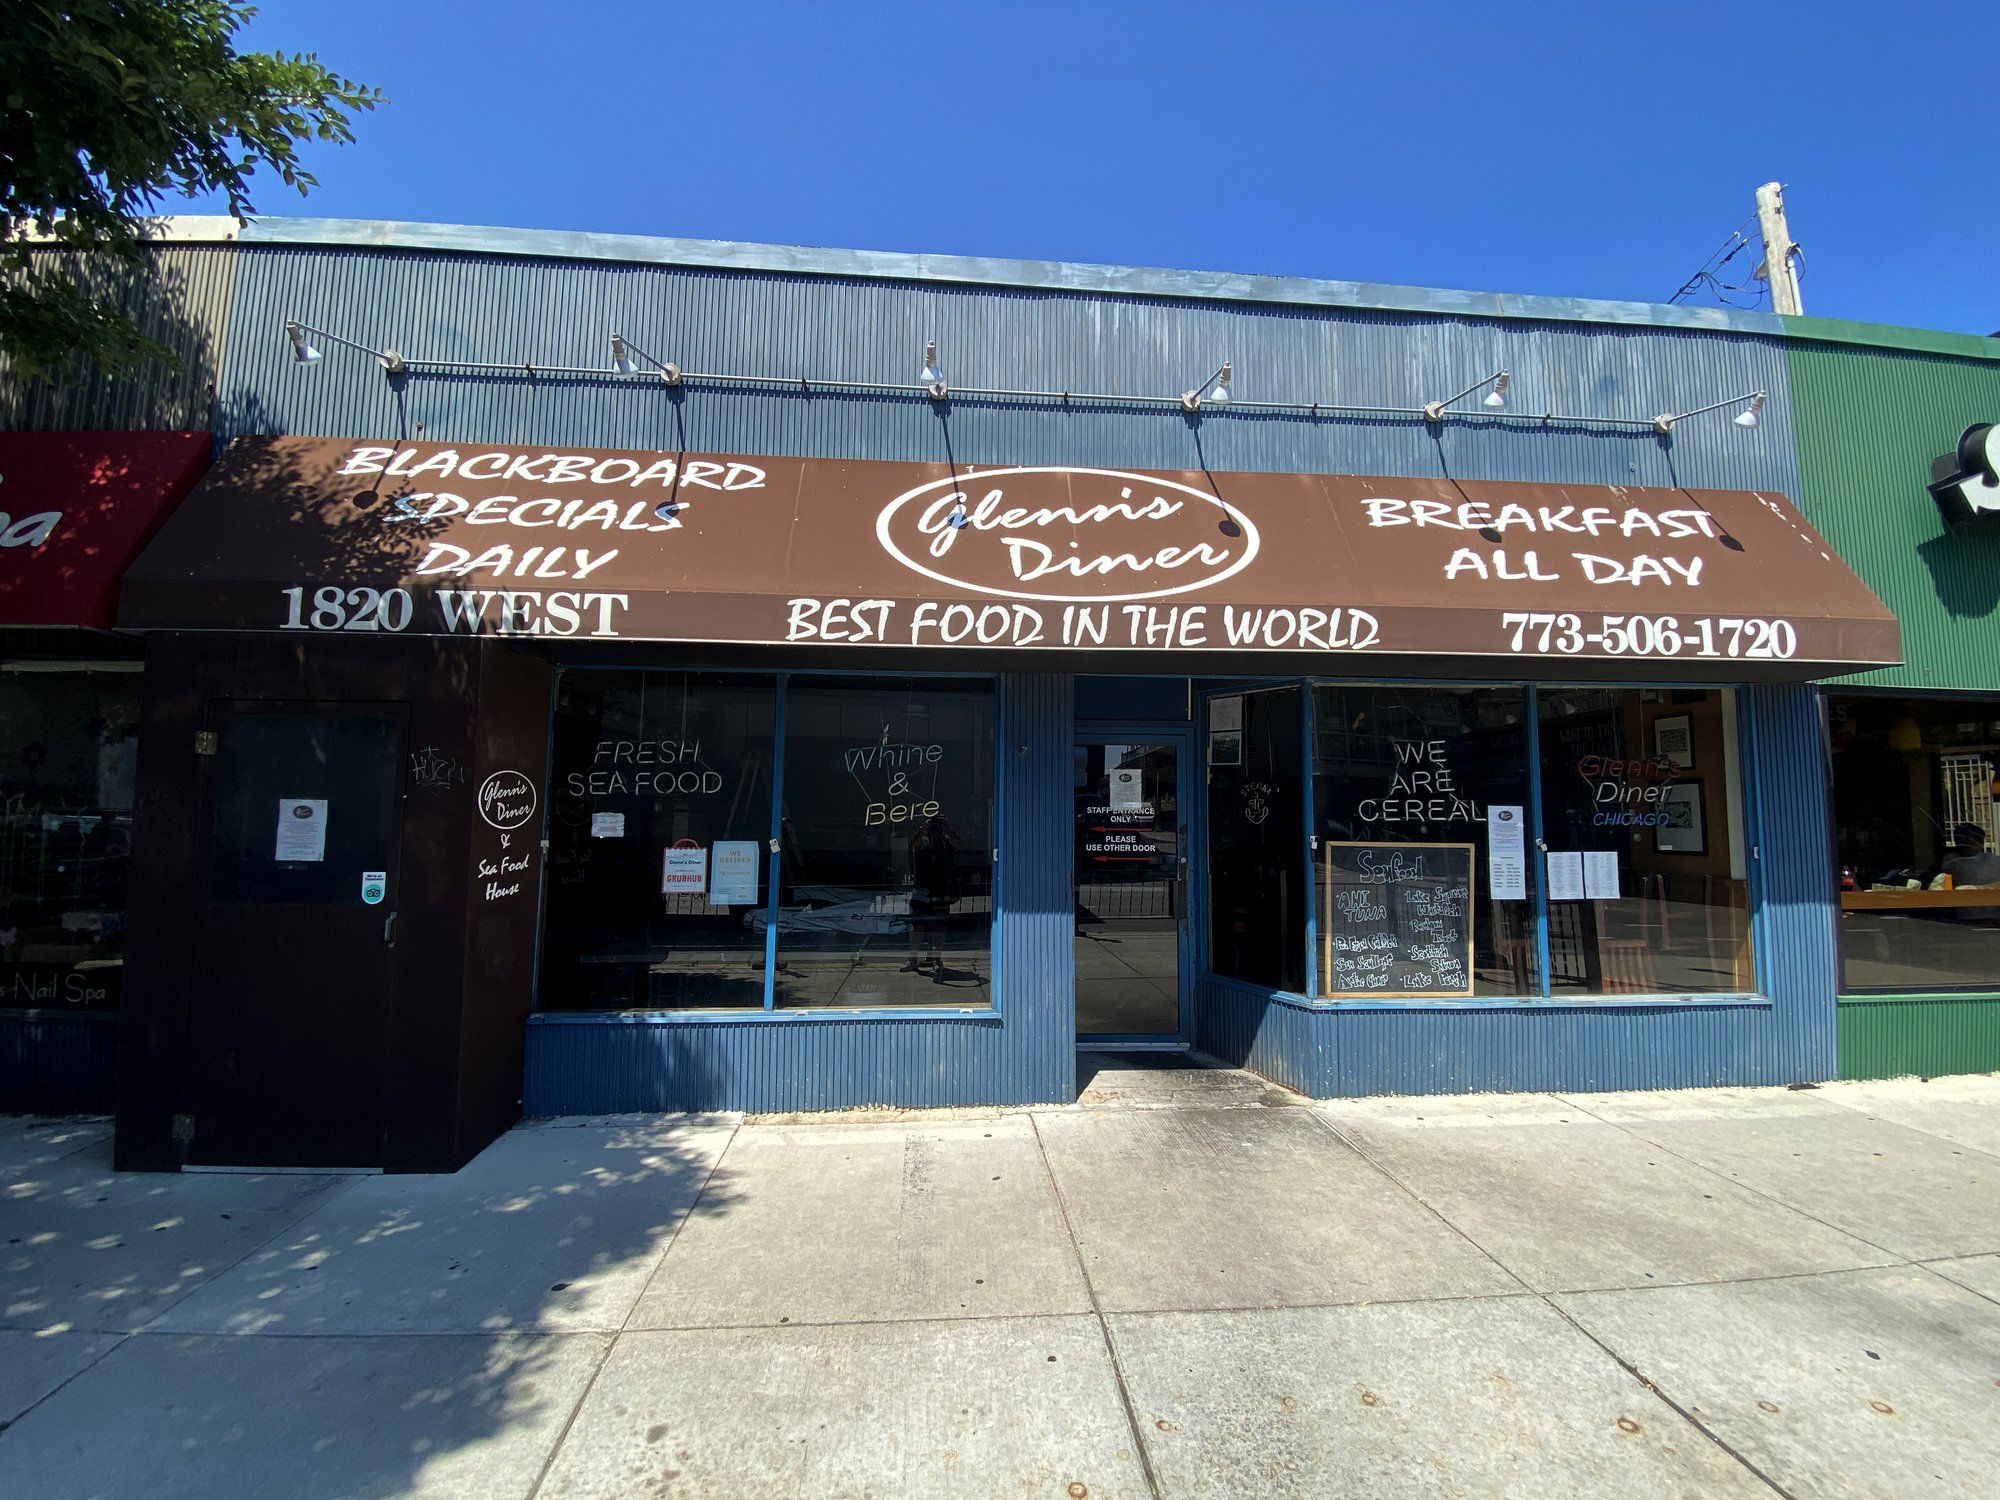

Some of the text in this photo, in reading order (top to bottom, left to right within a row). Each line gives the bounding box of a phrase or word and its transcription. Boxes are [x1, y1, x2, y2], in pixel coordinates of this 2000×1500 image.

[336, 446, 767, 491] BLACKBOARD
[383, 492, 691, 532] SPECIALS
[917, 487, 1184, 559] Glenn's
[1361, 498, 1715, 539] BREAKFAST
[415, 542, 619, 578] DAILY
[1001, 537, 1231, 582] Diner
[1444, 547, 1703, 587] ALL DAY
[279, 586, 629, 637] 1820 WEST
[785, 598, 1381, 650] BEST FOOD IN THE WORLD
[1502, 612, 1797, 659] 773-506-1720
[594, 739, 700, 764] FRESH
[844, 744, 943, 773] Whine
[1393, 740, 1448, 764] WE
[888, 772, 909, 796] &
[1390, 768, 1457, 796] ARE
[1596, 780, 1673, 803] Diner
[483, 780, 528, 812] Glenn's
[496, 801, 532, 821] Diner
[865, 800, 940, 827] Bere
[1086, 806, 1111, 815] STAFF
[1110, 815, 1132, 823] ONLY
[1358, 799, 1488, 823] CEREAL
[1592, 811, 1670, 827] CHICAGO
[500, 833, 511, 850] &
[1085, 844, 1156, 853] USE OTHER DOOR
[1105, 835, 1137, 844] PLEASE
[478, 853, 530, 879] Sea Food
[667, 874, 703, 883] GRUBHUB
[485, 881, 520, 901] House
[1338, 890, 1371, 910] AHI
[1344, 905, 1388, 923] TUNA
[15, 971, 58, 1001] Nail
[64, 973, 106, 1005] Spa
